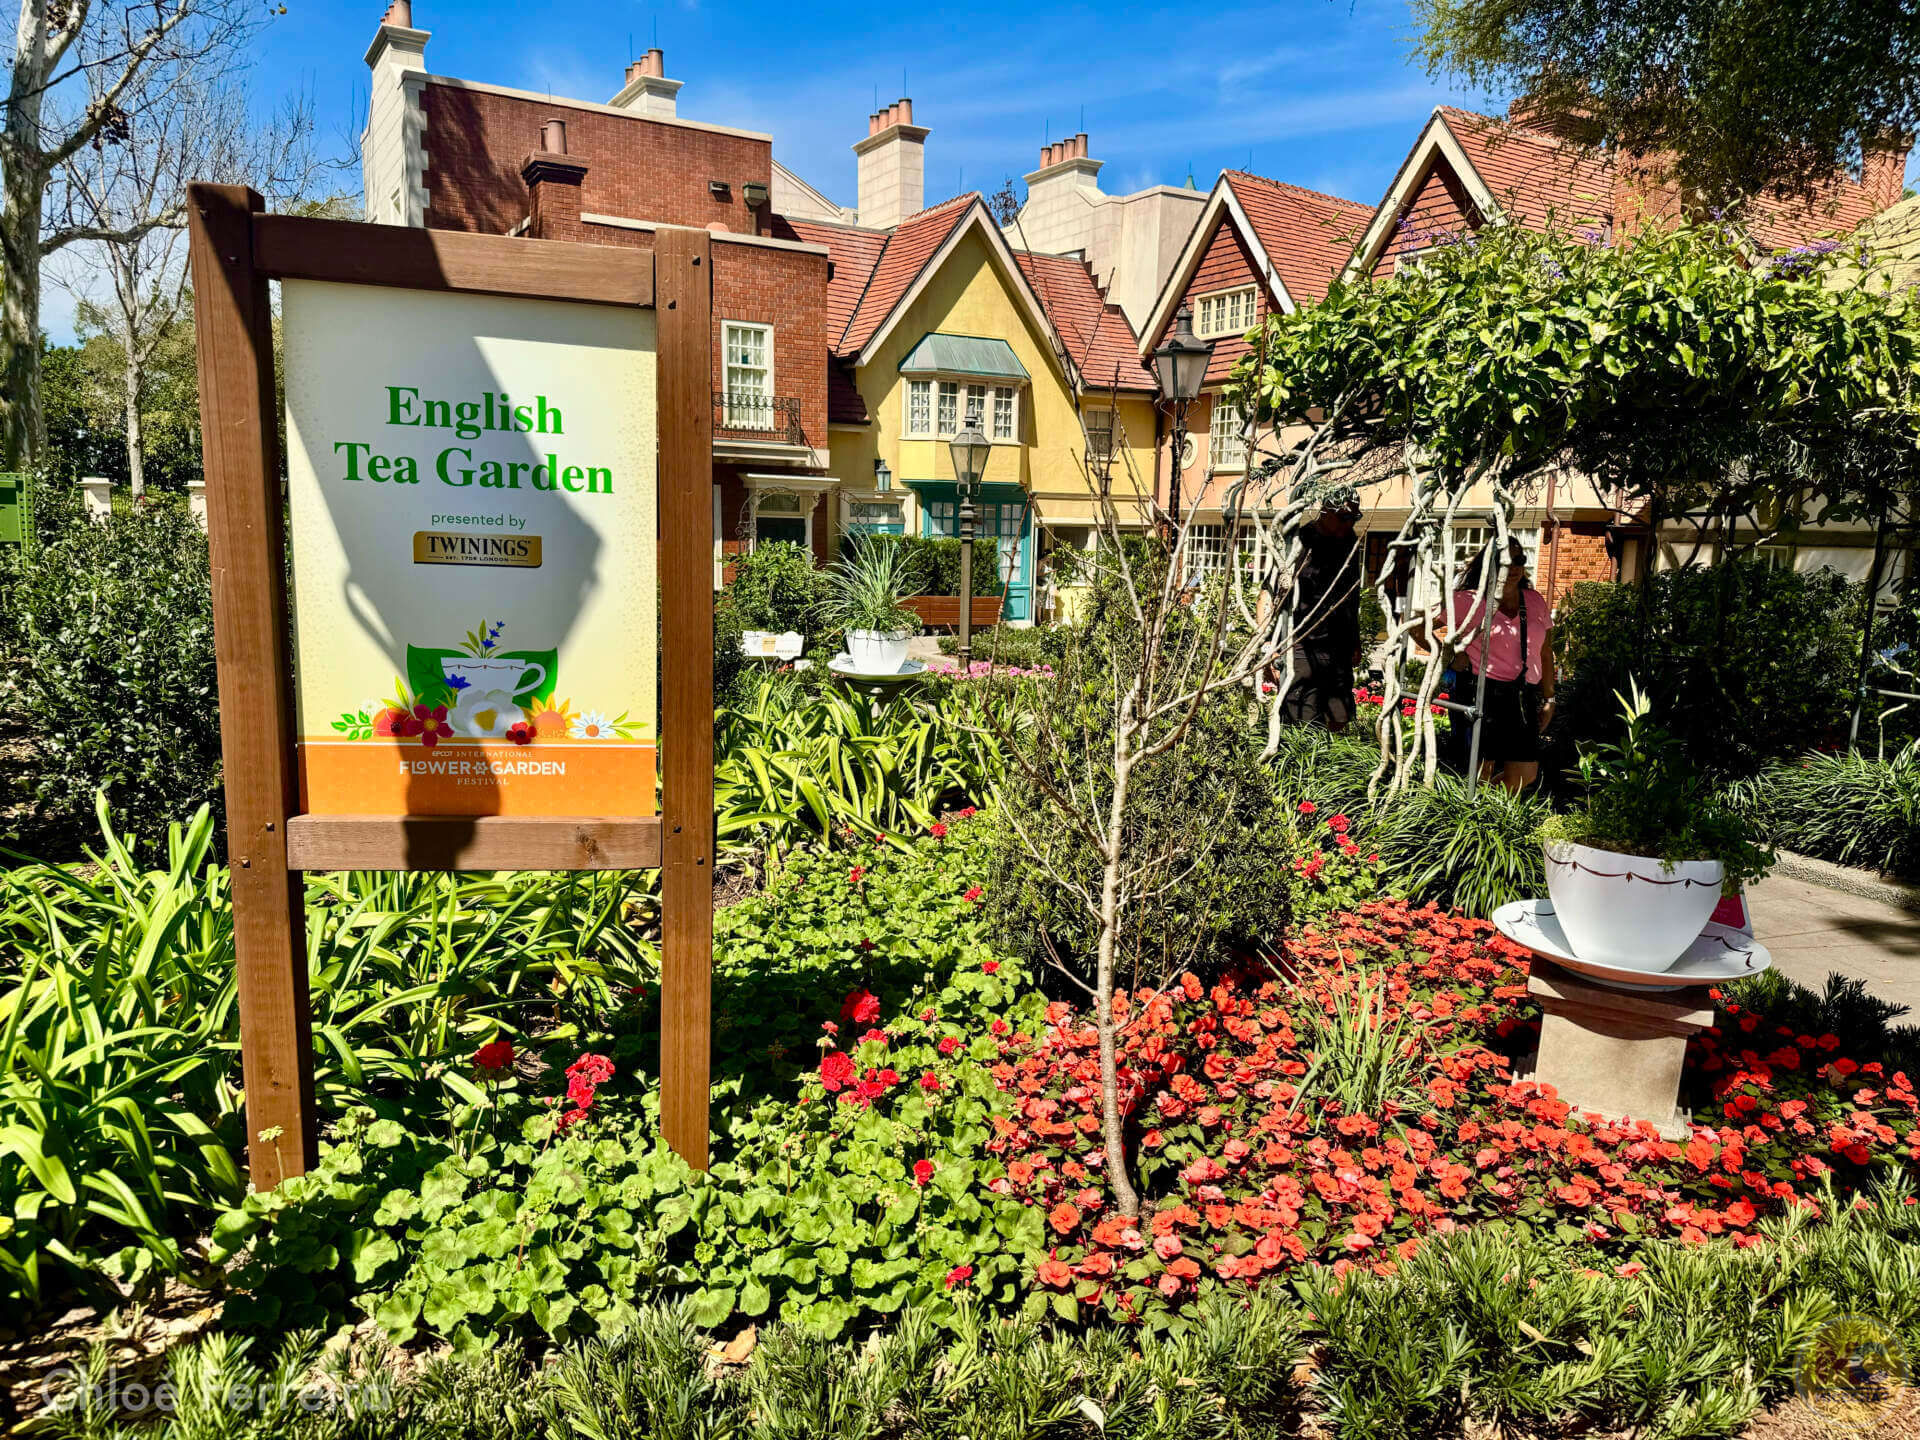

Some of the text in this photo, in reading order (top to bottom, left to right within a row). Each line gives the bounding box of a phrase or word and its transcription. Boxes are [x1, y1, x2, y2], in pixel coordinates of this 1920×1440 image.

[385, 386, 564, 440] English
[334, 441, 615, 494] Tea Garden
[431, 513, 526, 530] presented by
[399, 761, 566, 776] FLOWER GARDEN
